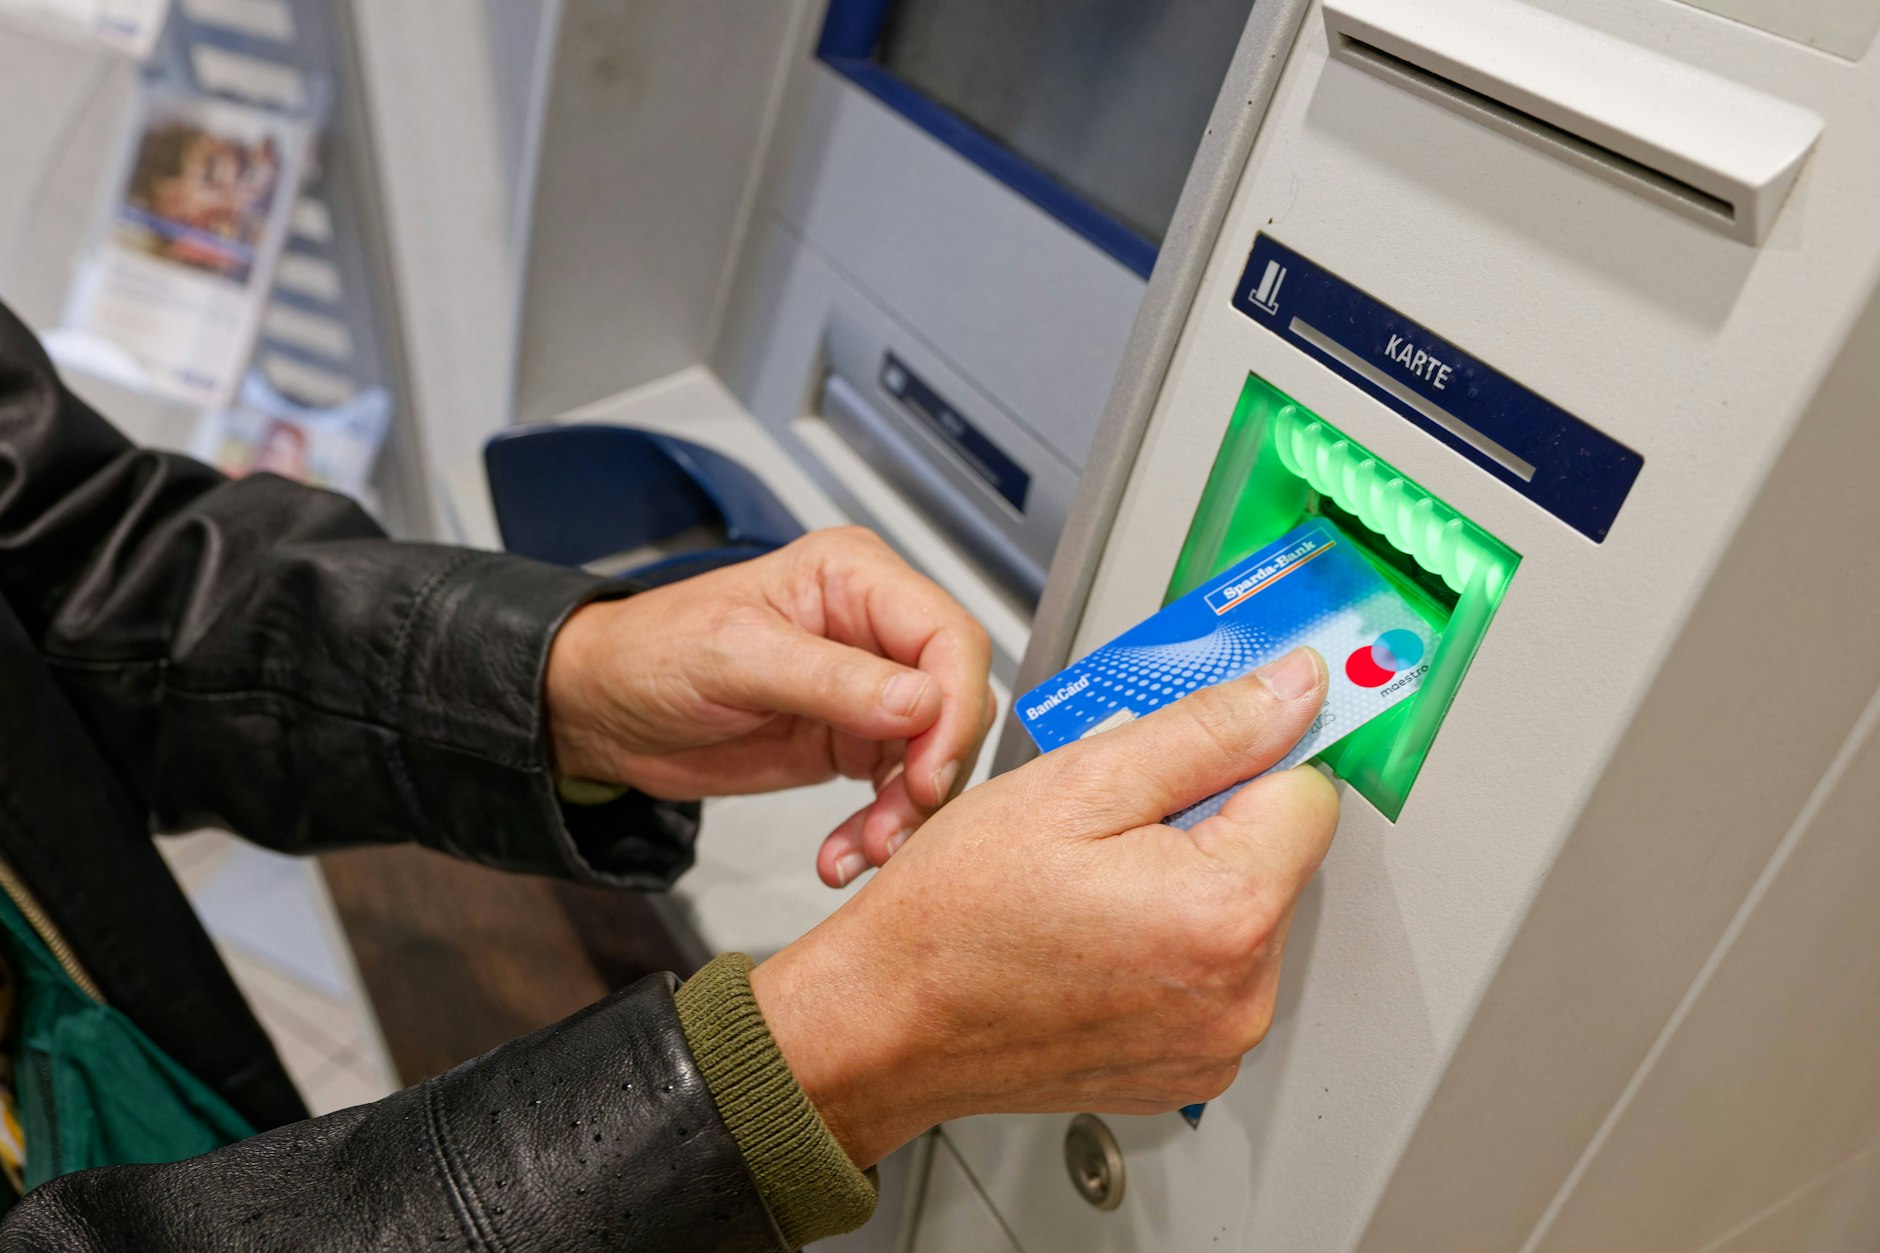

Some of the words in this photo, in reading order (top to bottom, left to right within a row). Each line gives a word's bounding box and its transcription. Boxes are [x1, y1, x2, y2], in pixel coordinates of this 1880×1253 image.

[1384, 334, 1453, 390] KARTE
[1223, 540, 1316, 600] Sparda-Bank
[1025, 675, 1090, 721] BankCard
[1380, 664, 1429, 698] maestro
